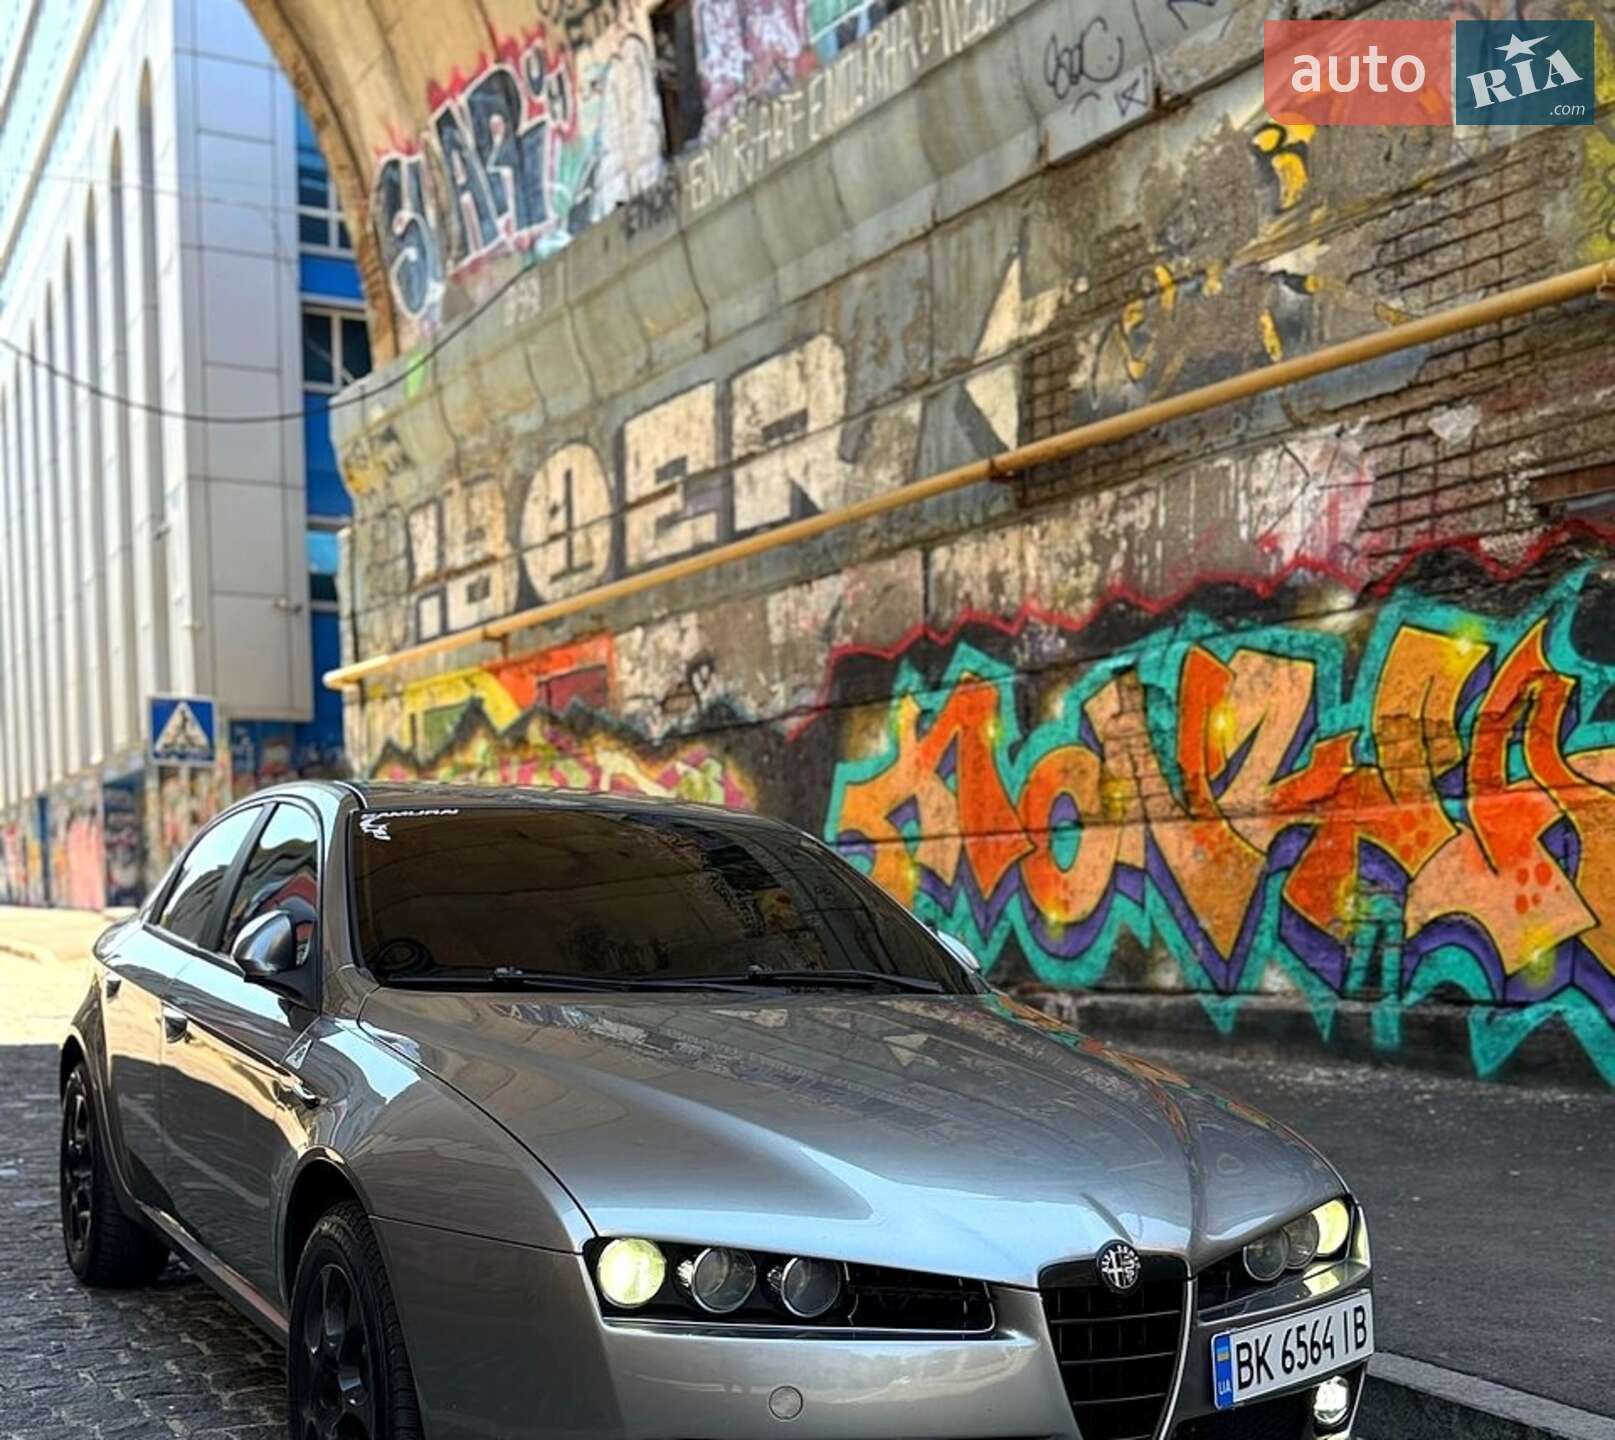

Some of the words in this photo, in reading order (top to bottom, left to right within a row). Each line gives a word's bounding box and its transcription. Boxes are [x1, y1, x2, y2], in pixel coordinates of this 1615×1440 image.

[1236, 1334, 1274, 1390] BK
[1281, 1316, 1335, 1374] 6564
[1343, 1304, 1368, 1355] IB
